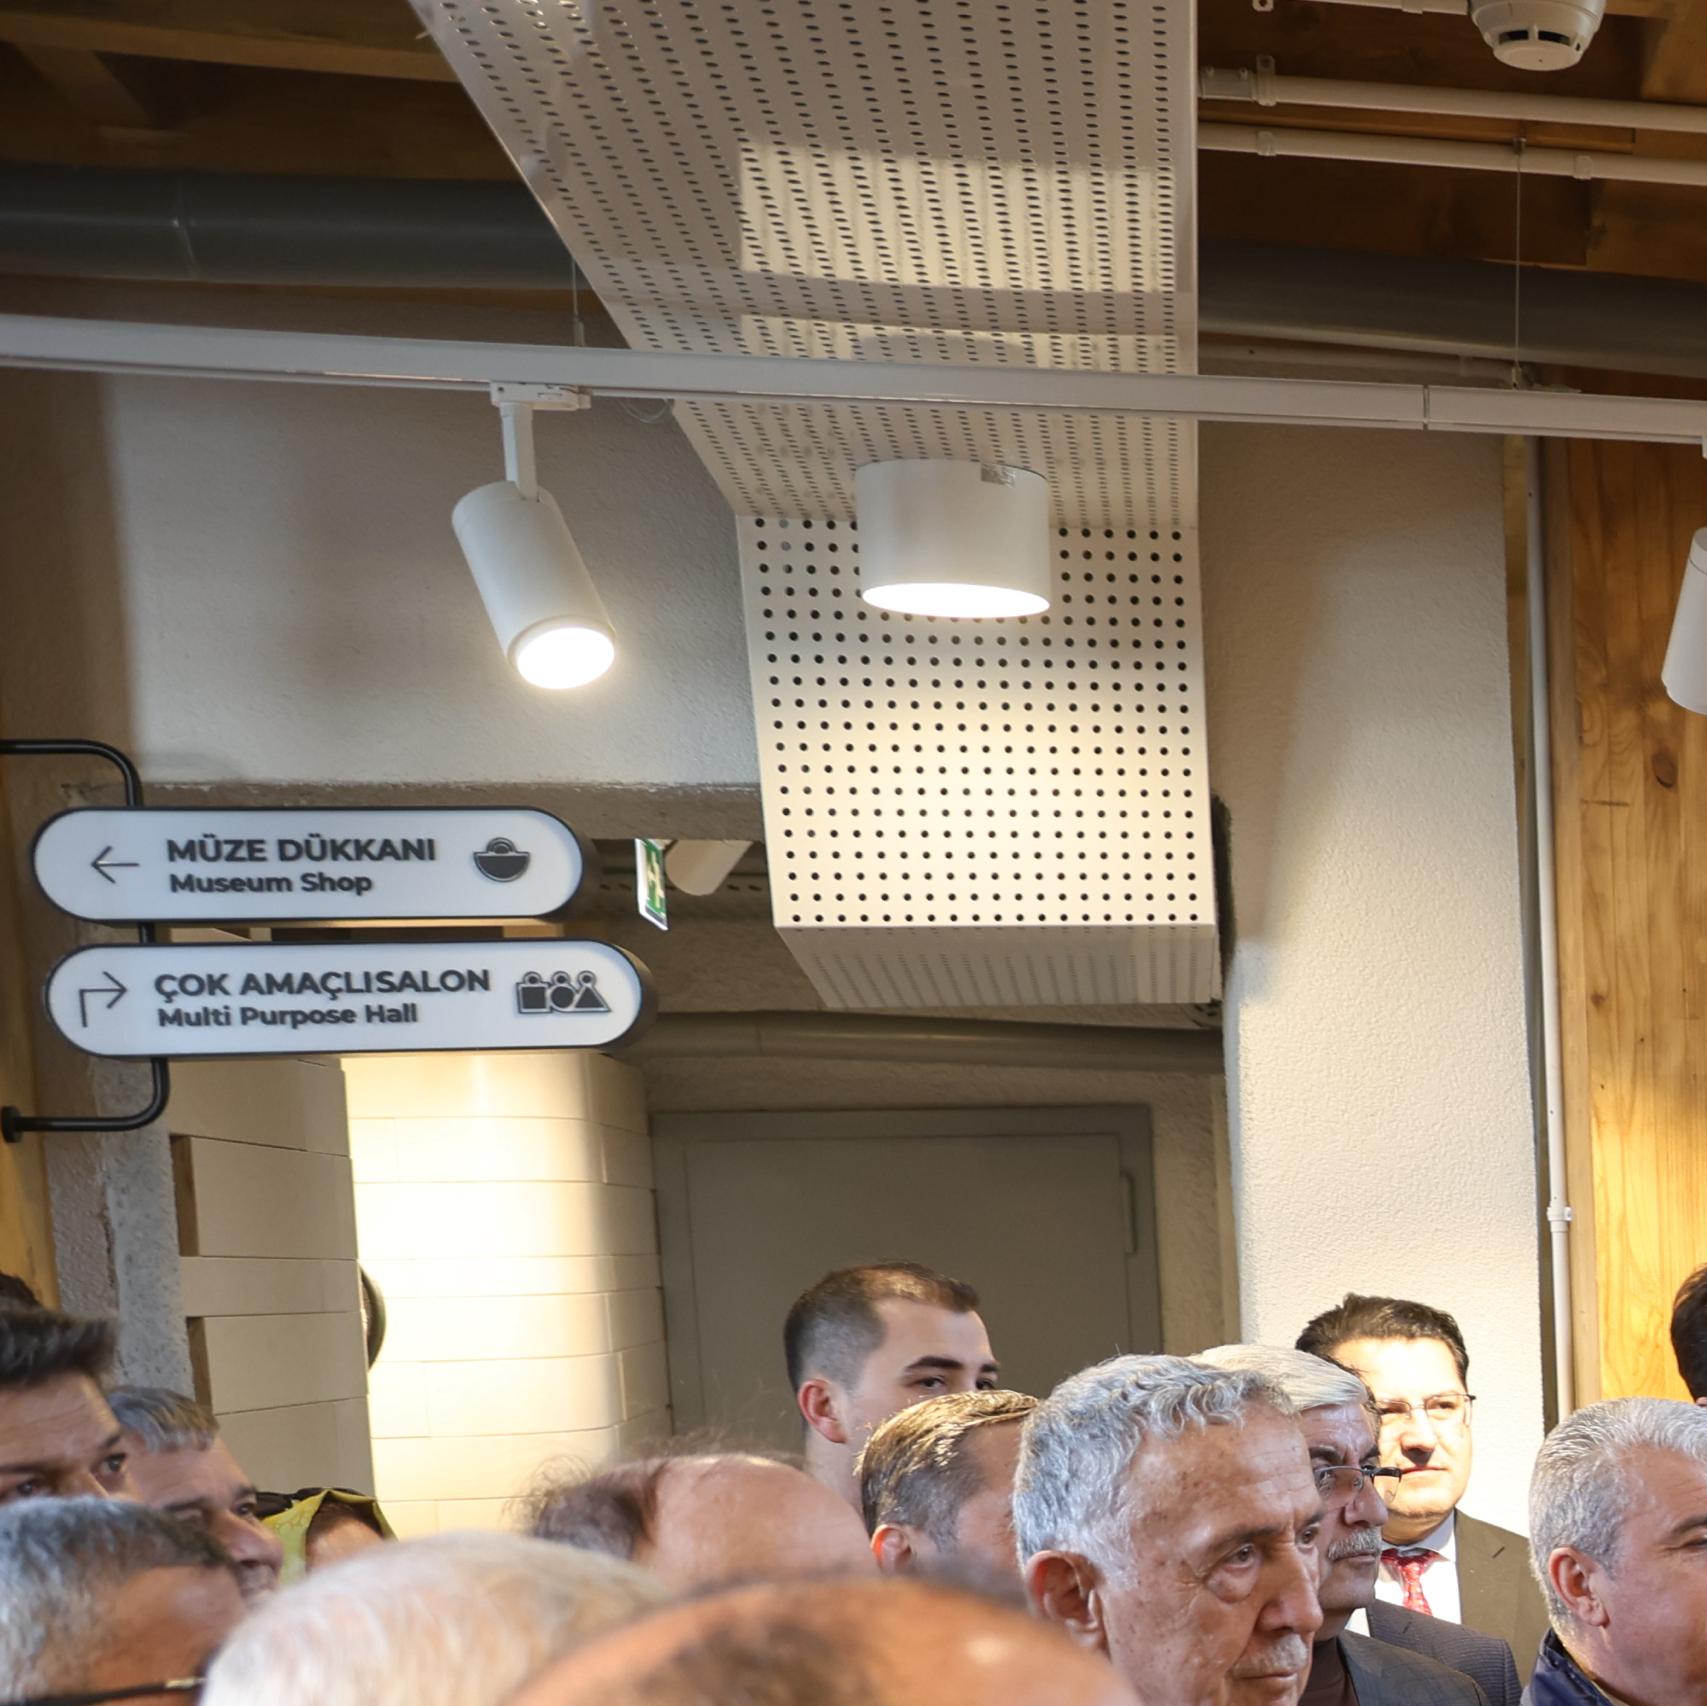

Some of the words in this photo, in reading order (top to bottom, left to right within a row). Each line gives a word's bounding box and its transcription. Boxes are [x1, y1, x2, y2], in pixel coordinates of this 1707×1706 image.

[166, 833, 267, 862] MÜZE
[277, 833, 436, 861] DÜKKANI
[169, 873, 292, 892] Museum
[300, 872, 372, 896] Shop
[154, 973, 230, 1003] ÇOK
[157, 1005, 231, 1027] Multi
[240, 1006, 357, 1030] Purpose
[365, 1003, 419, 1023] Hall
